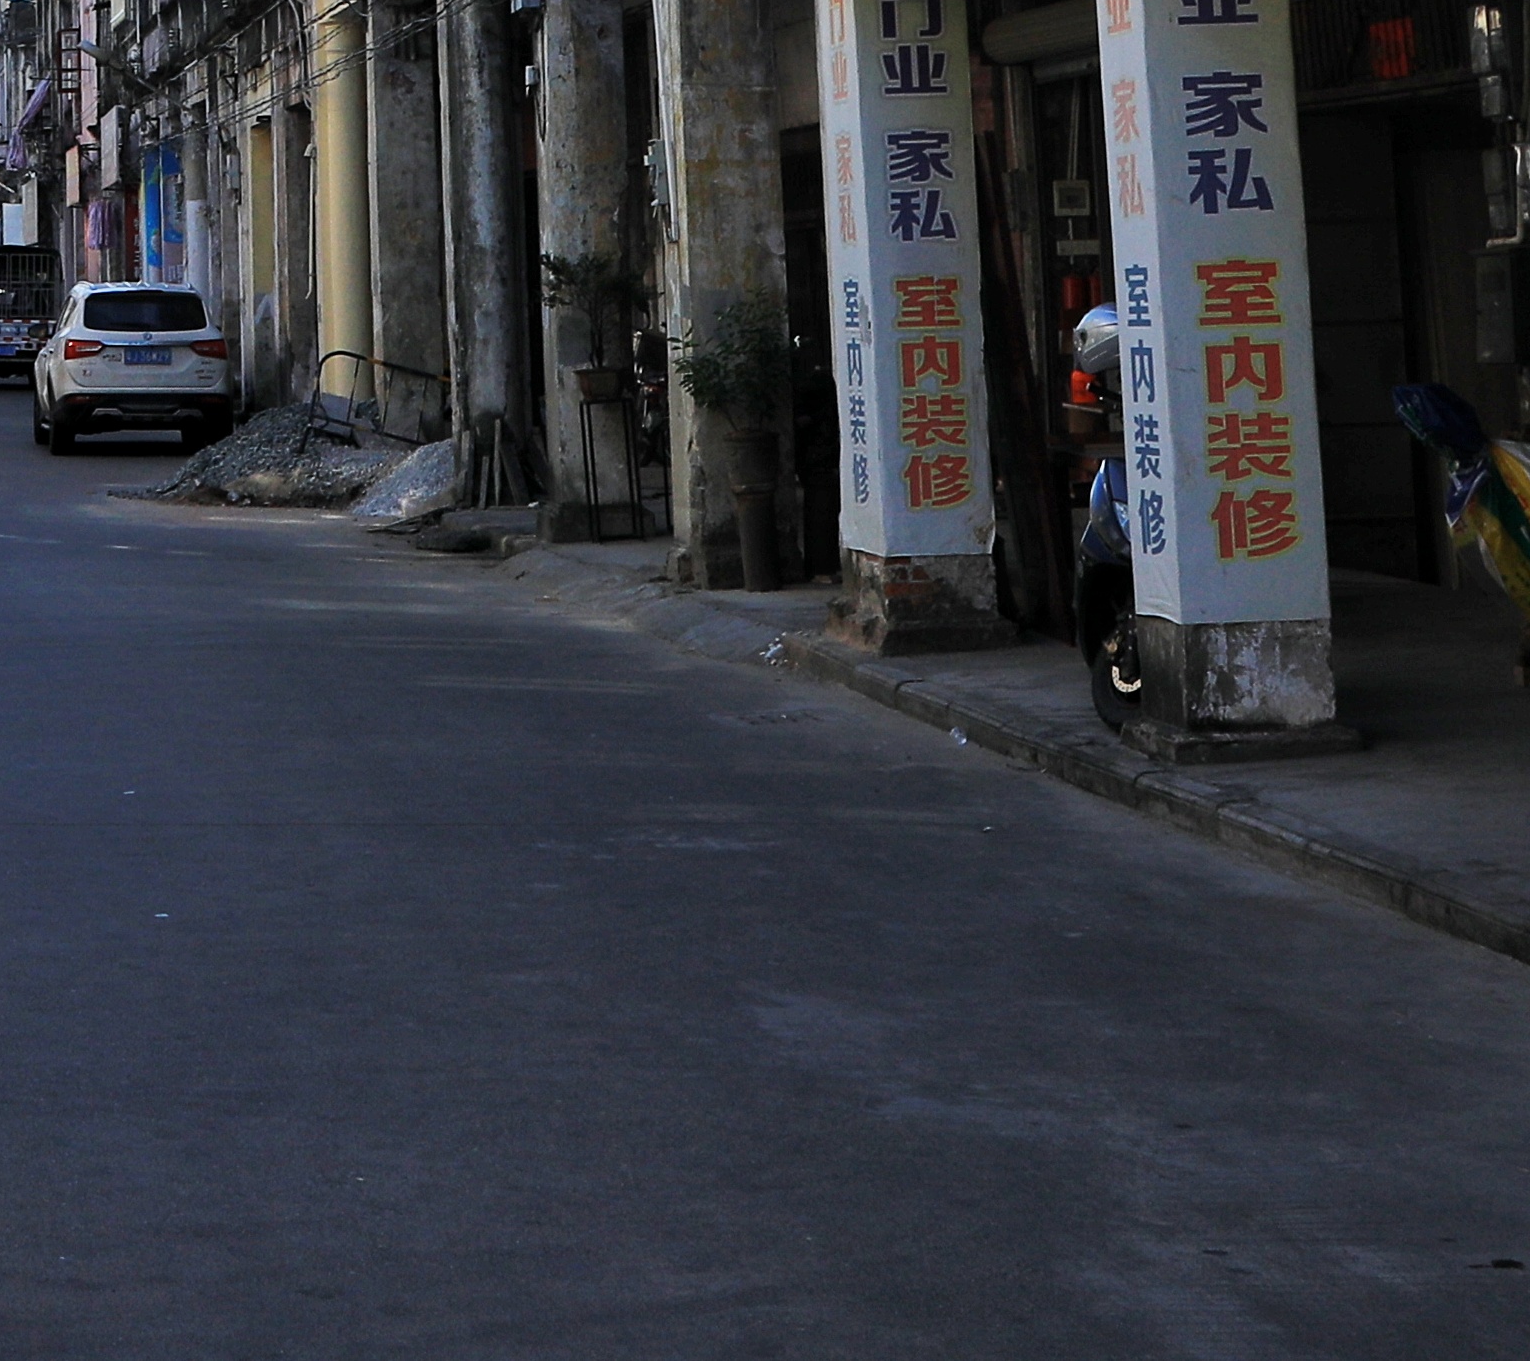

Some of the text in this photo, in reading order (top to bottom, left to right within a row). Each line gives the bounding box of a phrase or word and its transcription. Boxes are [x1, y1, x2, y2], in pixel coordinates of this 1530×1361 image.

[886, 130, 958, 243] 家私
[1110, 78, 1146, 218] 家私
[1182, 72, 1275, 215] 家私
[843, 278, 870, 504] 室内装修
[895, 275, 972, 509] 室内装修
[1124, 264, 1167, 556] 室内装修
[1196, 259, 1301, 561] 室内装修
